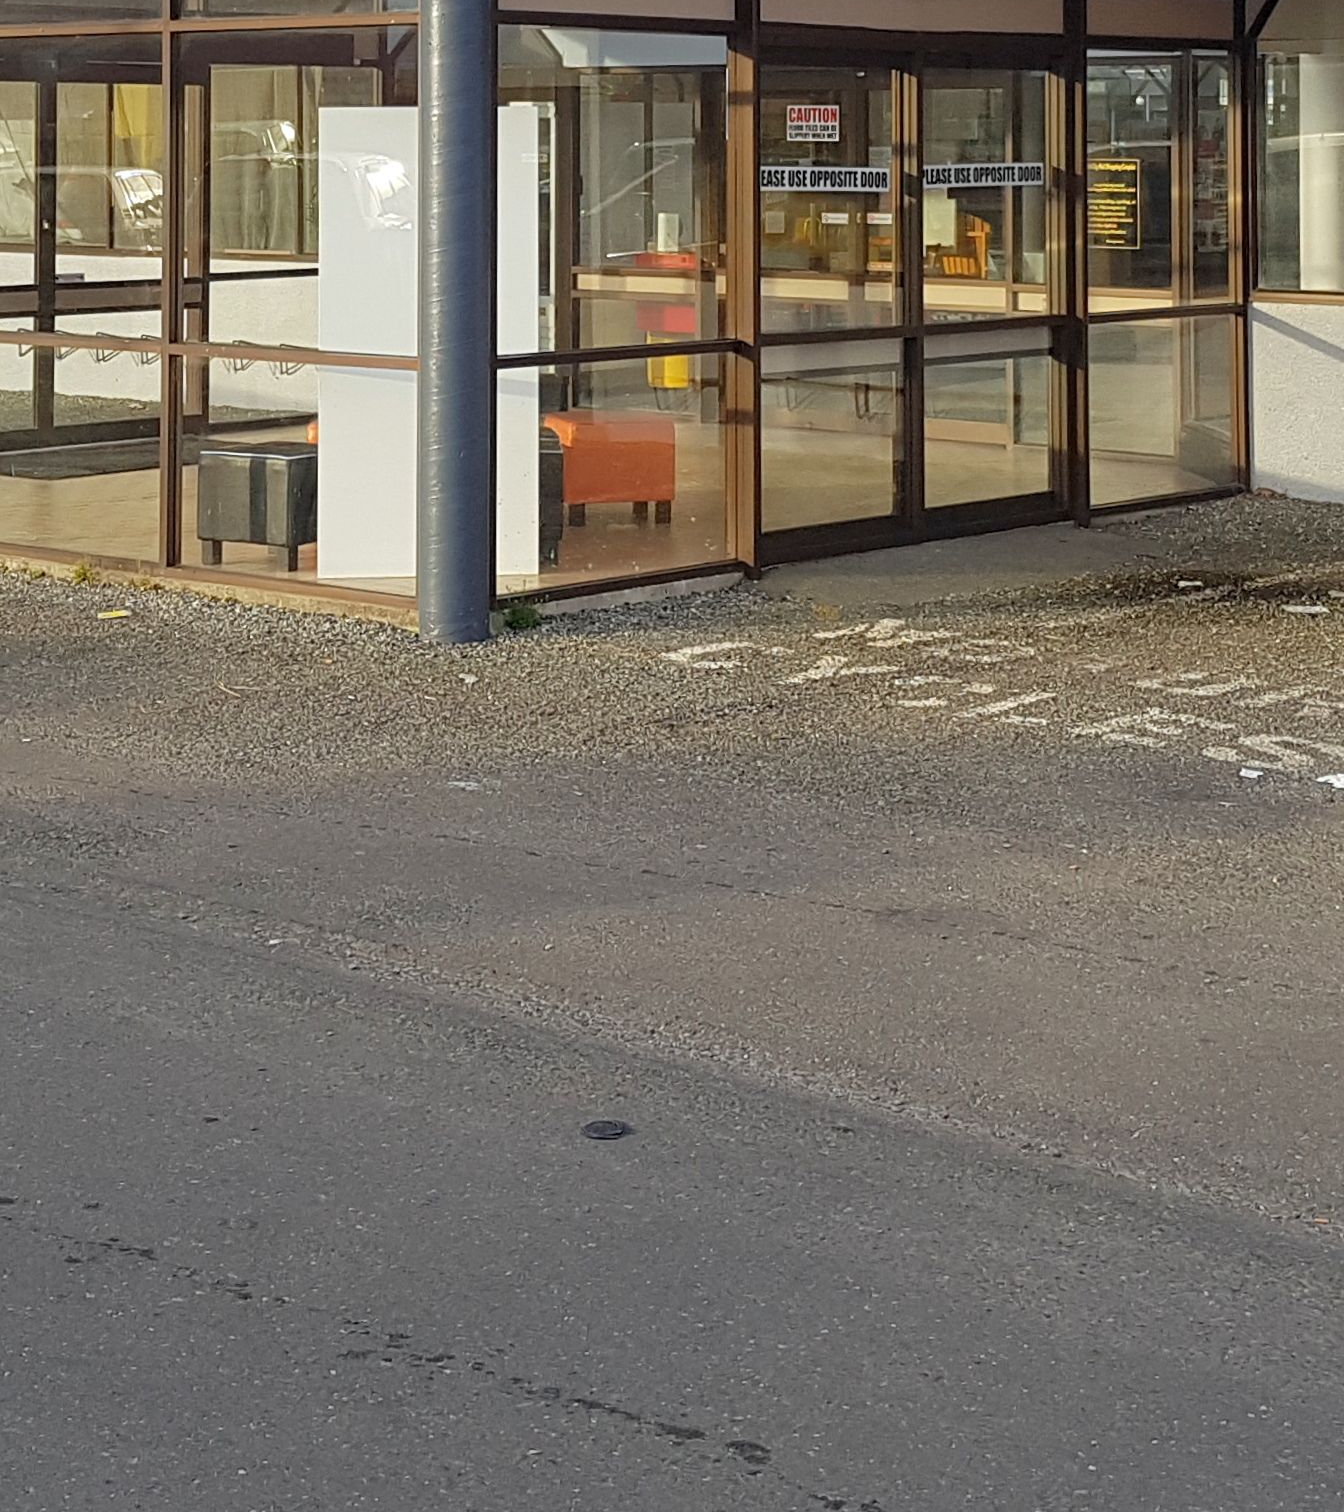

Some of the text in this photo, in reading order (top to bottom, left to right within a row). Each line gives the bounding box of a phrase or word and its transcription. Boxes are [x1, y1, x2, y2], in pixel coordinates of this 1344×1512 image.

[789, 107, 837, 123] CAUTION
[760, 170, 888, 189] EASE USE OPPOSITE DOOR
[954, 167, 971, 184] USE
[973, 166, 1016, 183] OPPOSITE
[1017, 166, 1042, 182] DOOR
